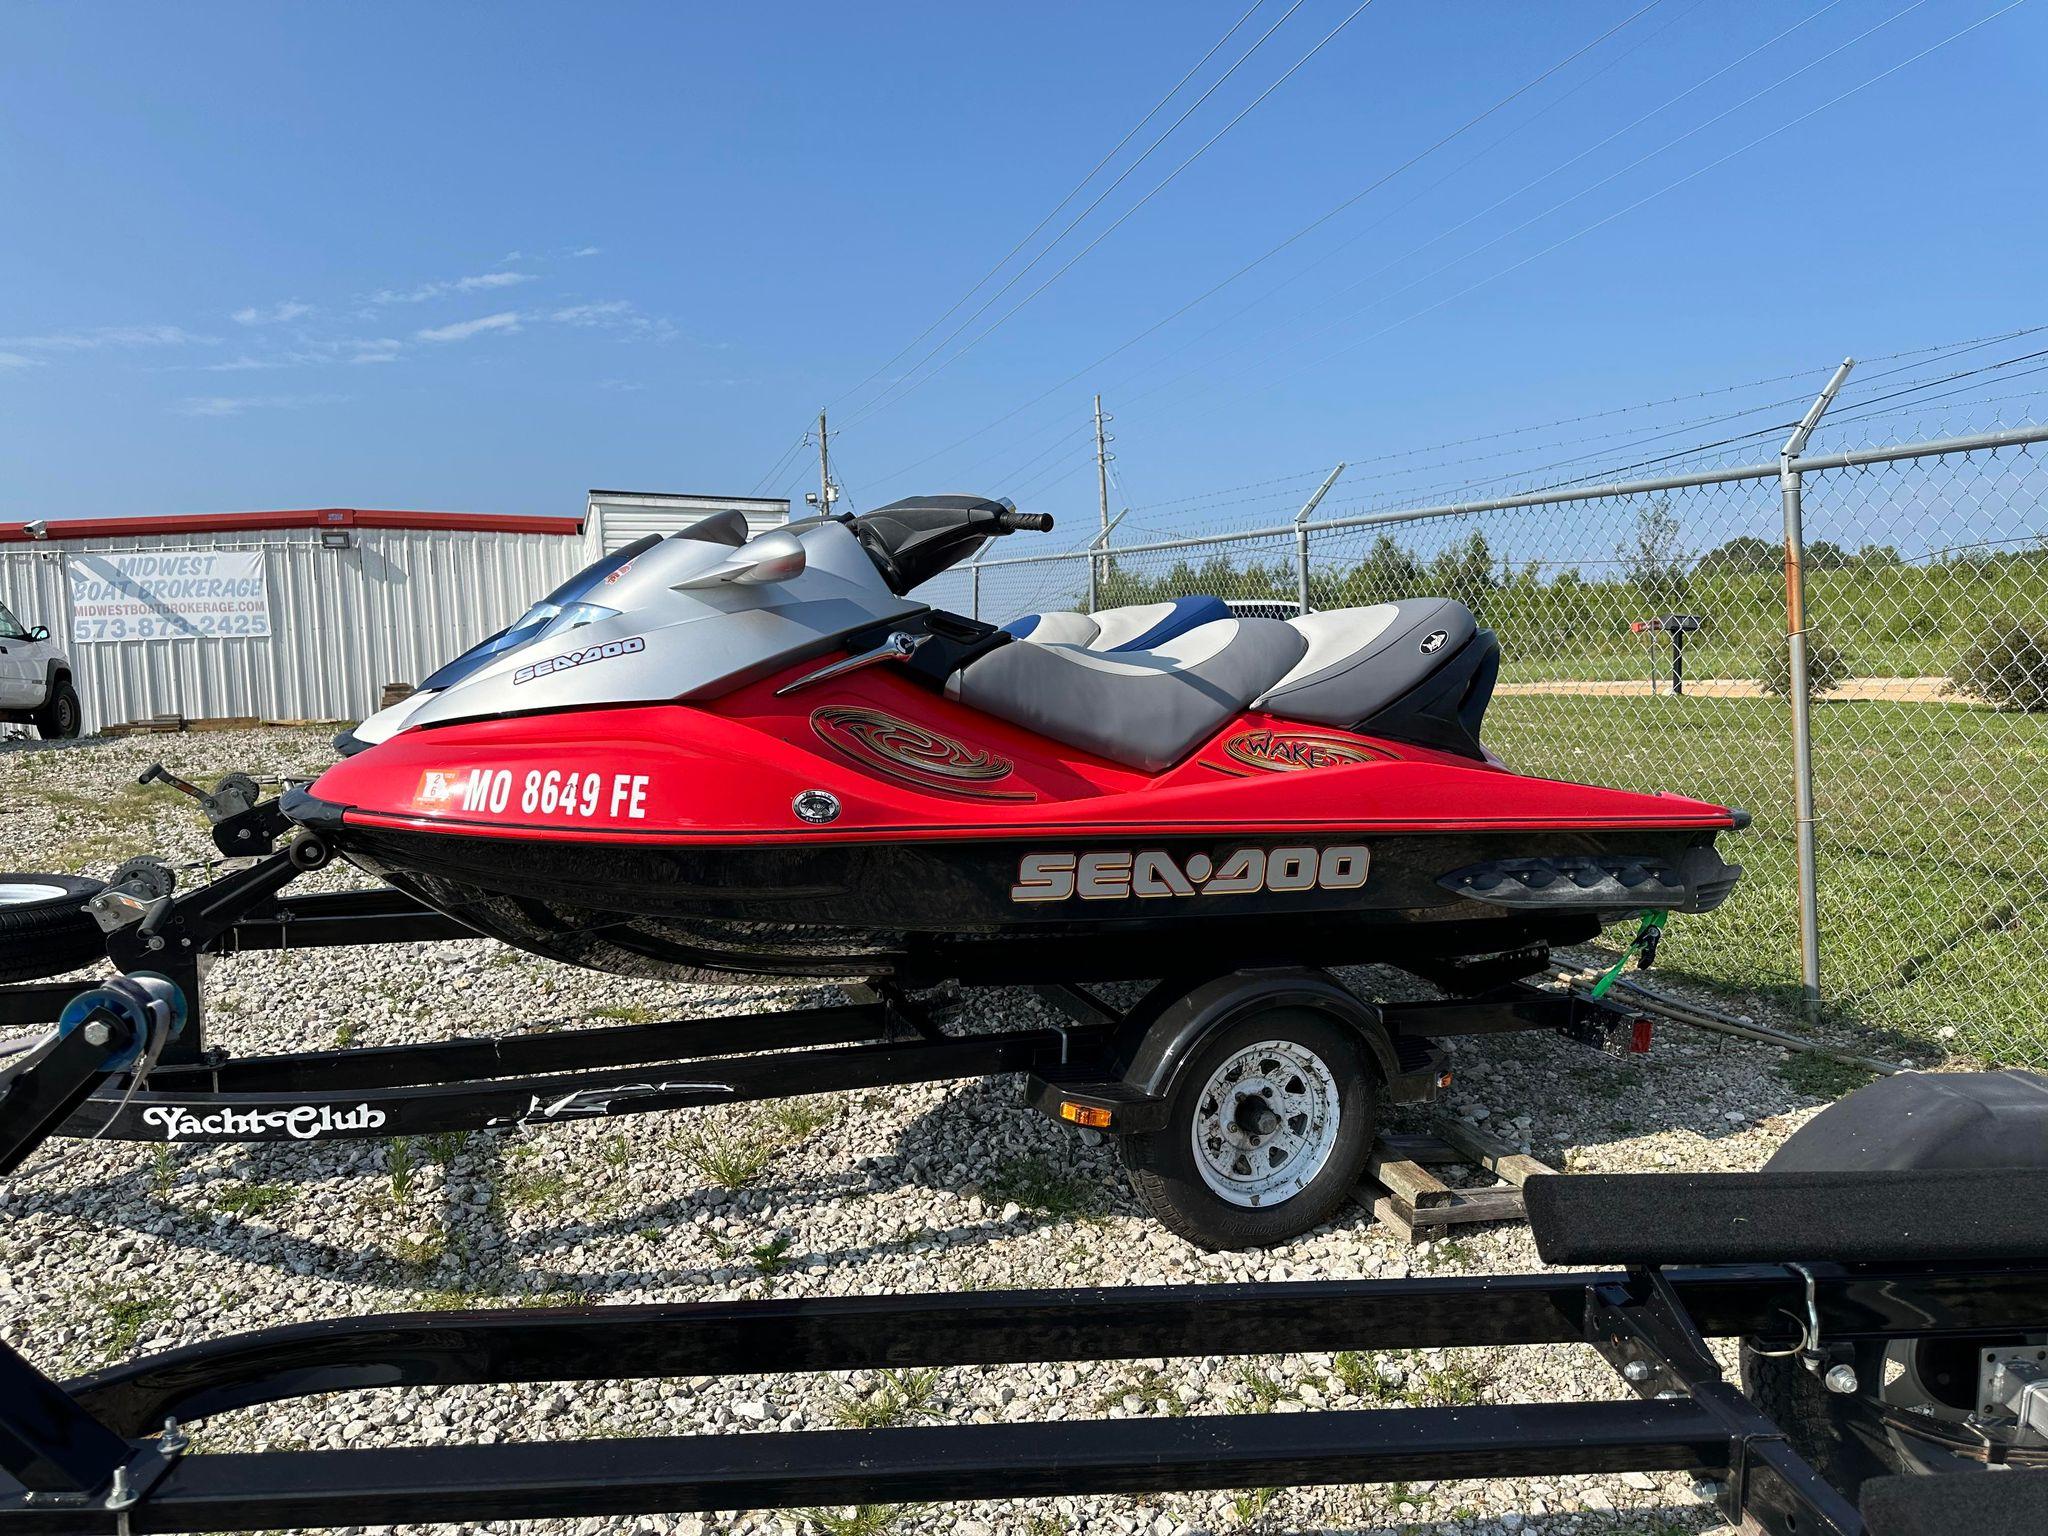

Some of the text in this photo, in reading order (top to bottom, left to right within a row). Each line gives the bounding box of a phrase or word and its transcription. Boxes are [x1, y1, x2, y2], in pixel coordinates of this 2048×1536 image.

[116, 556, 217, 577] MIDWEST
[74, 577, 263, 602] BOAT BROKERAGE
[74, 601, 265, 617] MIDWESTBOATBROKERAGE.COM
[75, 615, 267, 639] 573-873-2425
[1247, 729, 1330, 769] WAKE
[462, 769, 649, 819] MO 8649 FE
[142, 1103, 386, 1140] Yacht Club
